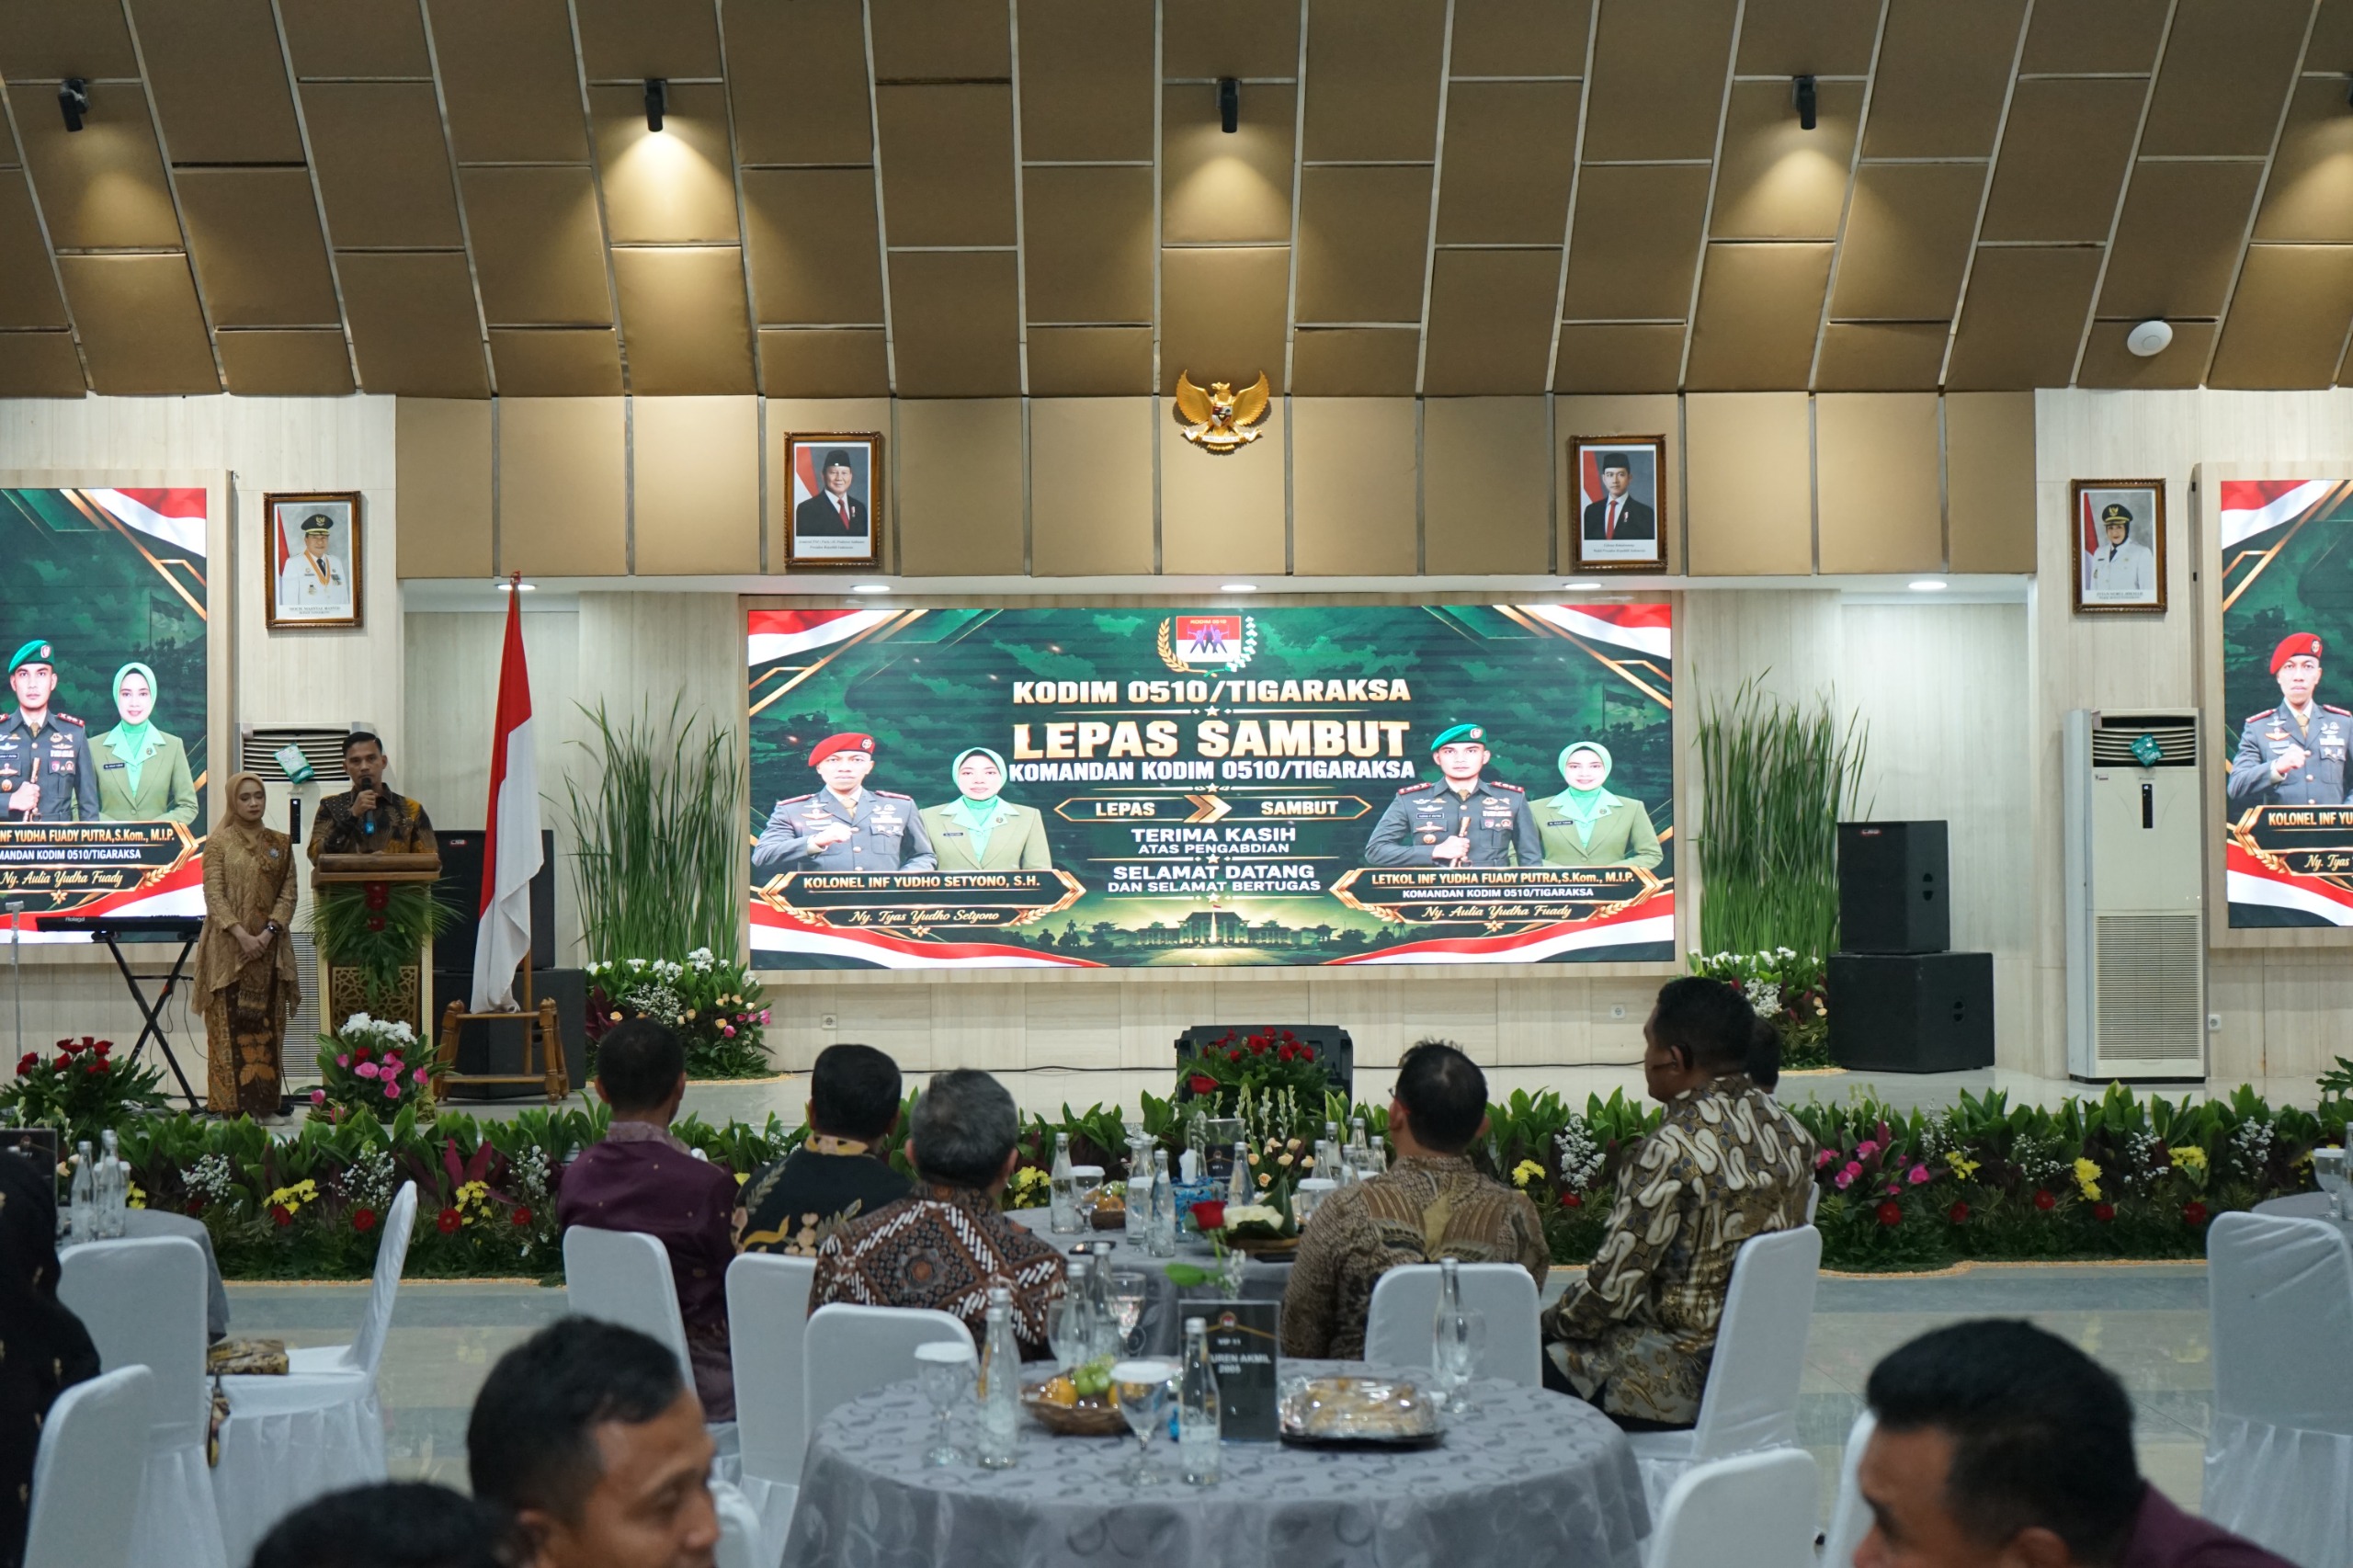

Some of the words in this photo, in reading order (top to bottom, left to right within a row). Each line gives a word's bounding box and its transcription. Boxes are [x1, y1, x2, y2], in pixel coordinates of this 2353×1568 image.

[1014, 681, 1117, 703] KODIM
[1128, 679, 1411, 703] 0510/TIGARAKSA
[1014, 722, 1177, 759] LEPAS
[1198, 720, 1410, 757] SAMBUT
[1009, 762, 1133, 781] KOMANDAN
[1142, 761, 1213, 779] KODIM
[1222, 760, 1415, 779] 0510/TIGARAKSA
[1096, 802, 1155, 816] LEPAS
[1261, 801, 1338, 815] SAMBUT
[2268, 812, 2317, 825] KOLONEL
[2319, 812, 2336, 824] INF
[0, 830, 12, 842] NF
[14, 830, 46, 842] YUDHA
[49, 830, 79, 842] FUADY
[151, 829, 175, 841] M.I.P.
[1131, 828, 1218, 842] TERIMA
[1226, 828, 1295, 842] KASIH
[37, 849, 64, 859] KODIM
[67, 849, 142, 859] 0510/TIGARAKSA
[1138, 845, 1180, 854] ATAS
[1185, 844, 1289, 854] PENGABDIAN
[2304, 854, 2324, 871] Ny.
[2327, 854, 2349, 871] Tyas
[21, 870, 51, 885] Aulia
[53, 870, 88, 888] Yudha
[91, 869, 123, 888] Fuady
[1113, 867, 1221, 881] SELAMAT
[1225, 865, 1314, 879] DATANG
[1372, 874, 1415, 884] LETKOL
[1418, 874, 1437, 884] INF
[1439, 873, 1478, 883] YUDHA
[1482, 873, 1518, 883] FUADY
[1606, 872, 1634, 882] M.I.P.
[804, 877, 865, 889] KOLONEL
[869, 877, 890, 888] INF
[893, 877, 941, 888] YUDHO
[945, 876, 1010, 889] SETYONO,
[1014, 876, 1040, 886] S.H.
[1108, 882, 1141, 892] DAN
[1147, 881, 1224, 892] SELAMAT
[1228, 880, 1321, 891] BERTUGAS
[1403, 890, 1464, 898] KOMANDAN
[1467, 889, 1501, 898] KODIM
[1504, 888, 1594, 898] 0510/TIGARAKSA
[848, 910, 872, 924] Ny.
[877, 911, 906, 925] Tyas
[910, 911, 950, 924] Yudho
[952, 910, 1000, 923] Setyono
[1422, 906, 1444, 919] Ny.
[1448, 905, 1483, 917] Aulia
[1488, 905, 1529, 919] Yudha
[1532, 904, 1572, 919] Fuady
